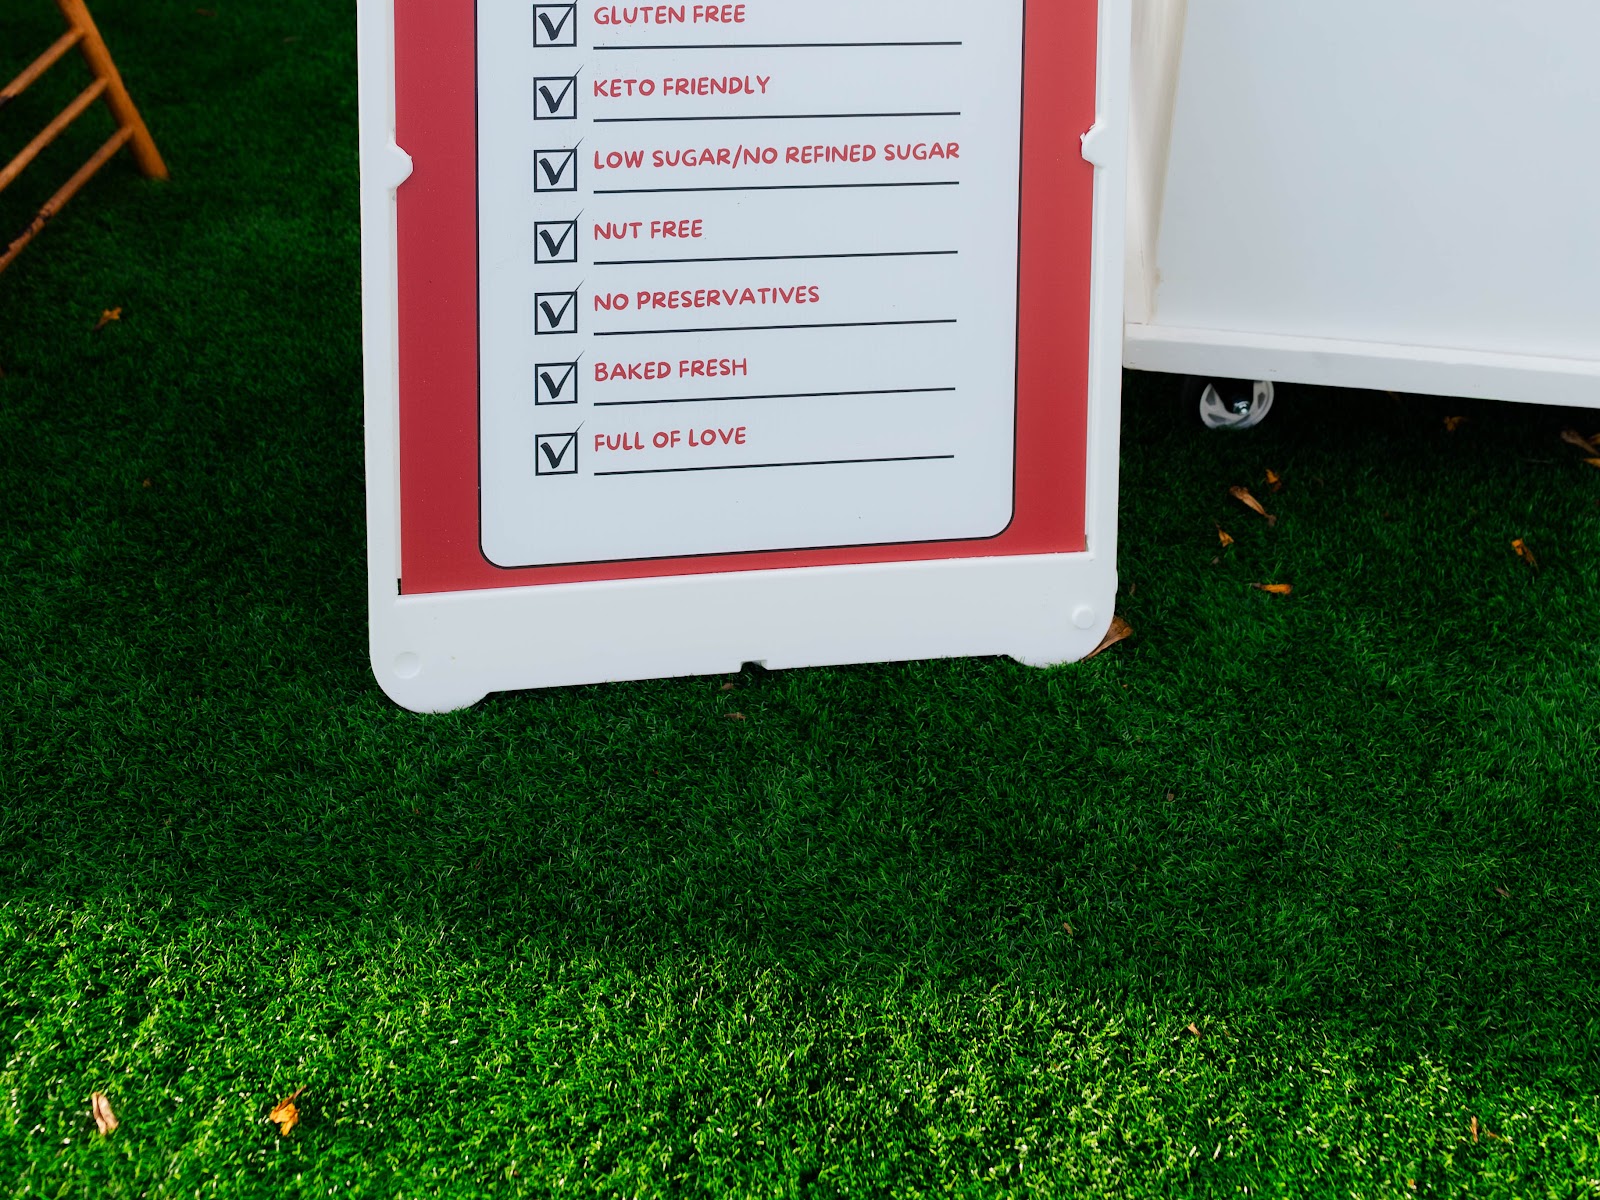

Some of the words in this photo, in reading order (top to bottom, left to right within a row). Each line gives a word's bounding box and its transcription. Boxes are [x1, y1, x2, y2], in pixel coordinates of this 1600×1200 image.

[593, 5, 686, 25] GLUTEN
[693, 4, 745, 24] FREE
[593, 78, 655, 98] KETO
[663, 75, 770, 96] FRIENDLY
[593, 150, 645, 170] LOW
[652, 145, 778, 169] SUGAR/NO
[785, 144, 877, 165] REFINED
[884, 142, 959, 161] SUGAR
[593, 221, 643, 240] NUT
[650, 219, 703, 239] FREE
[594, 293, 629, 311] NO
[637, 285, 820, 310] PRESERVATIVES
[594, 361, 671, 383] BAKED
[679, 358, 747, 378] FRESH
[594, 431, 645, 452] FULL
[652, 429, 681, 449] OF
[688, 426, 746, 447] LOVE
